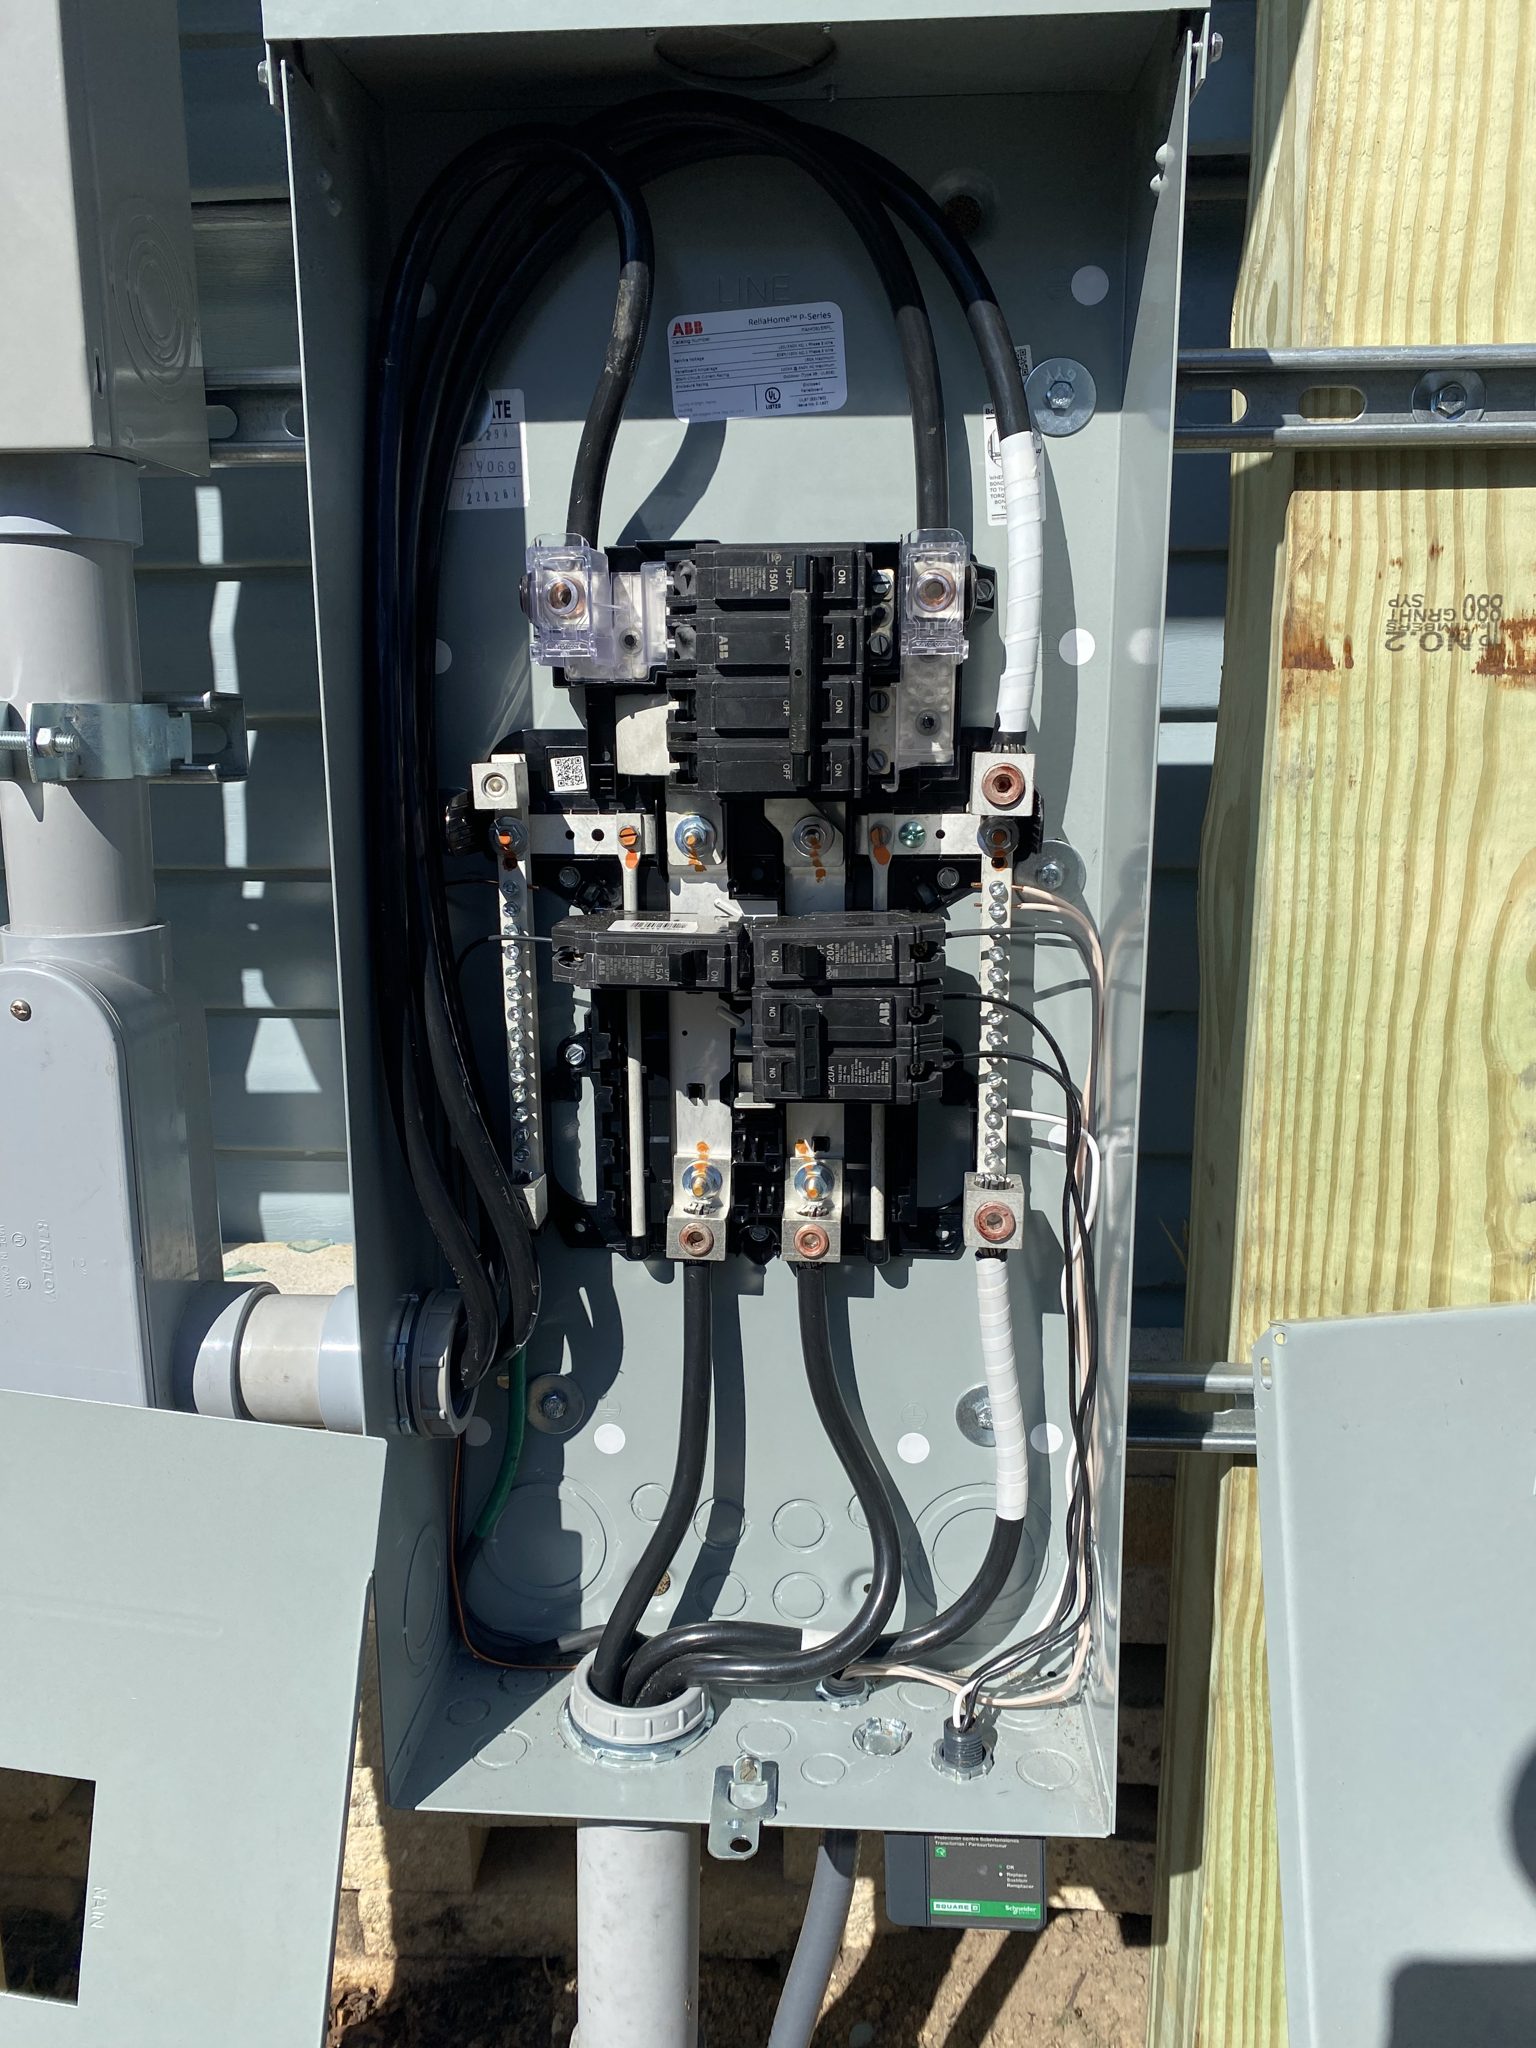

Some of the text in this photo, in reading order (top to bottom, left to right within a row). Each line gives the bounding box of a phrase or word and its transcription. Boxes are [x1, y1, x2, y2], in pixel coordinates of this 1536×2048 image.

[717, 275, 791, 304] LINE
[799, 311, 832, 321] P-Series
[672, 321, 703, 336] ABB
[493, 400, 511, 419] TE
[768, 568, 779, 593] 150A
[837, 569, 846, 584] ON
[1387, 594, 1503, 622] 880 GRNHT
[1389, 594, 1425, 608] SYP
[718, 635, 729, 659] ABB
[836, 634, 844, 649] ON
[782, 699, 790, 716] OFF
[835, 700, 843, 714] ON
[782, 763, 791, 780] OFF
[834, 763, 842, 777] ON
[771, 949, 779, 963] ON
[826, 943, 835, 961] 20A
[597, 958, 606, 976] ABB
[655, 962, 664, 982] 15A
[711, 970, 719, 982] ON
[768, 1005, 777, 1018] ON
[878, 1001, 891, 1026] ABB
[768, 1066, 777, 1079] ON
[827, 1065, 835, 1083] 20A
[90, 1887, 108, 1929] MAIN
